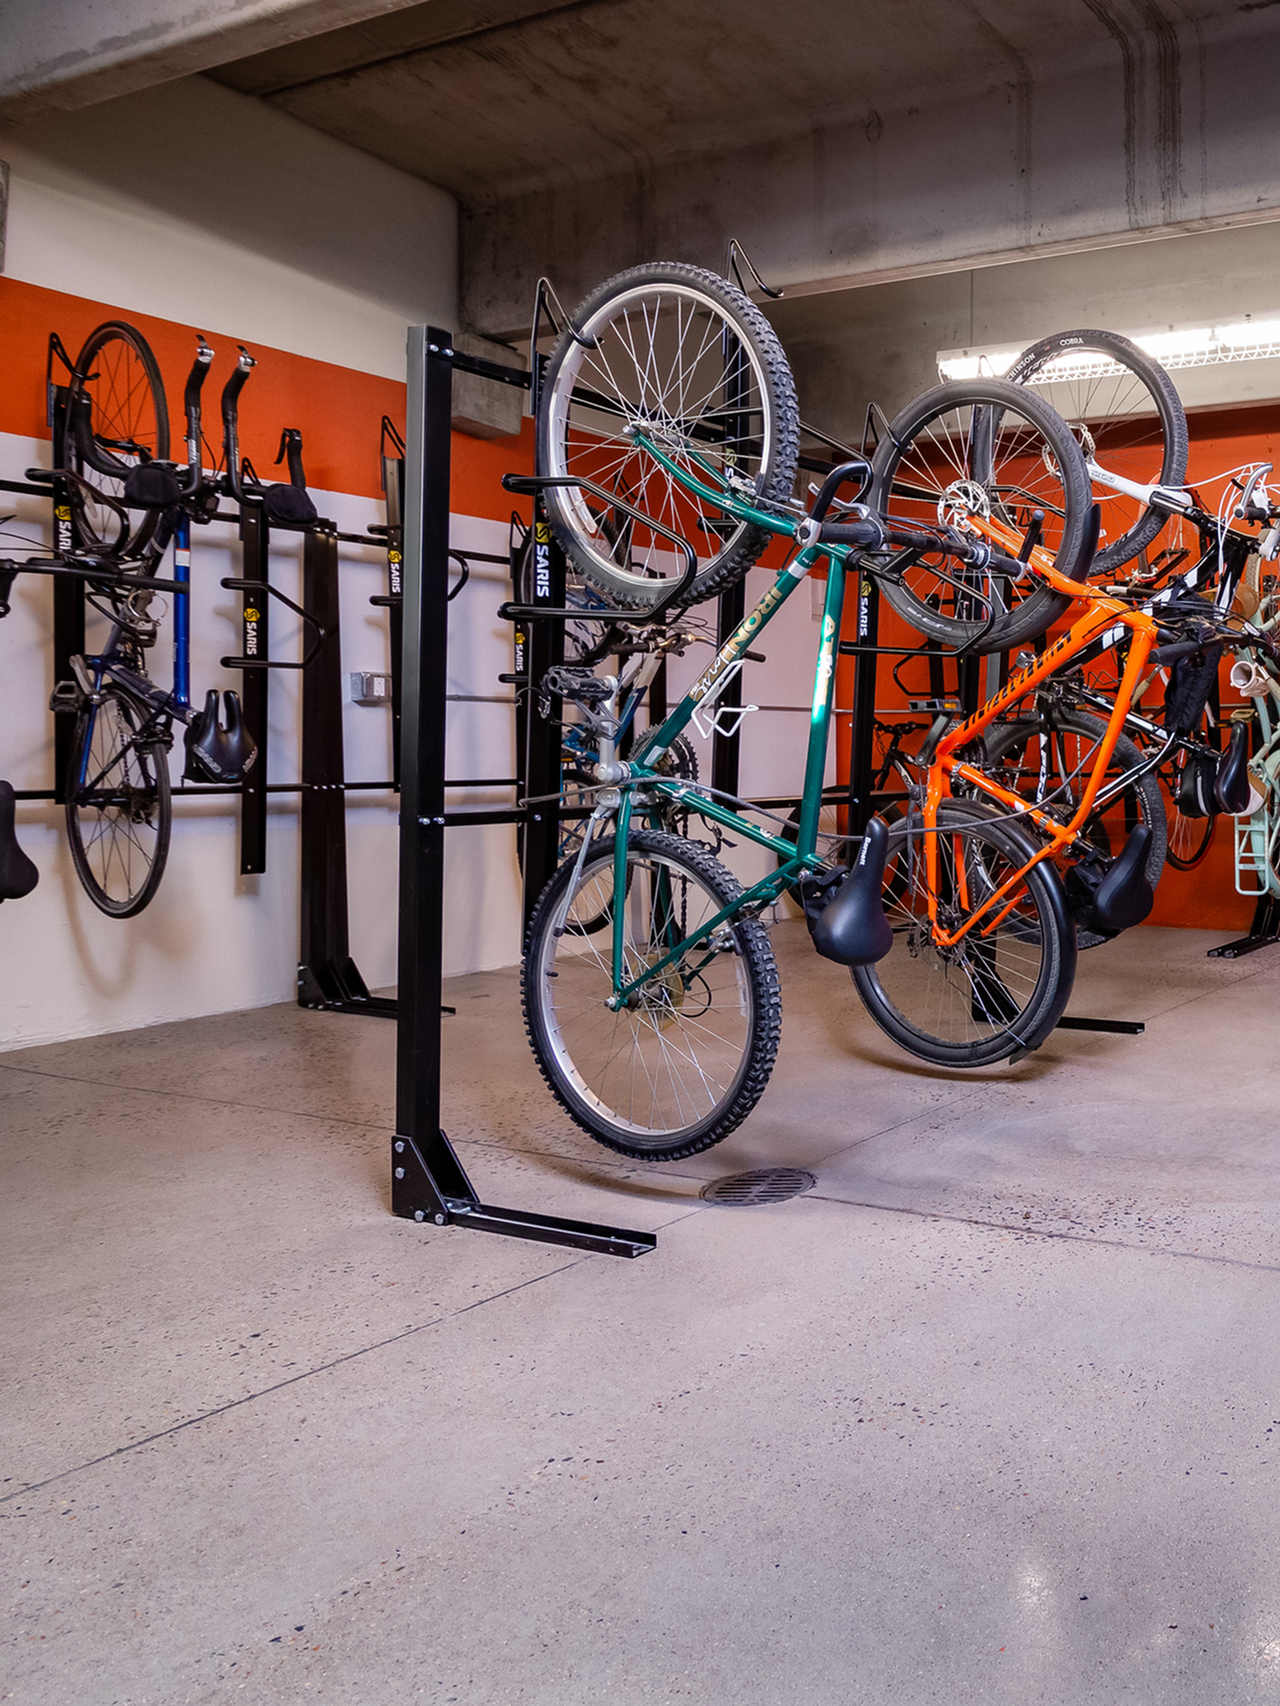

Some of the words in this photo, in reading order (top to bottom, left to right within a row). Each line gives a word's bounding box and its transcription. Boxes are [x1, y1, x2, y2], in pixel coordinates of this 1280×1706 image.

[1006, 352, 1036, 382] CHINSON
[58, 520, 73, 551] SARI
[390, 562, 402, 593] SARIS
[535, 543, 551, 598] SARIS
[727, 585, 784, 652] IRON
[859, 596, 869, 637] SARIS
[246, 621, 258, 656] SARIS
[515, 643, 524, 672] SARIS
